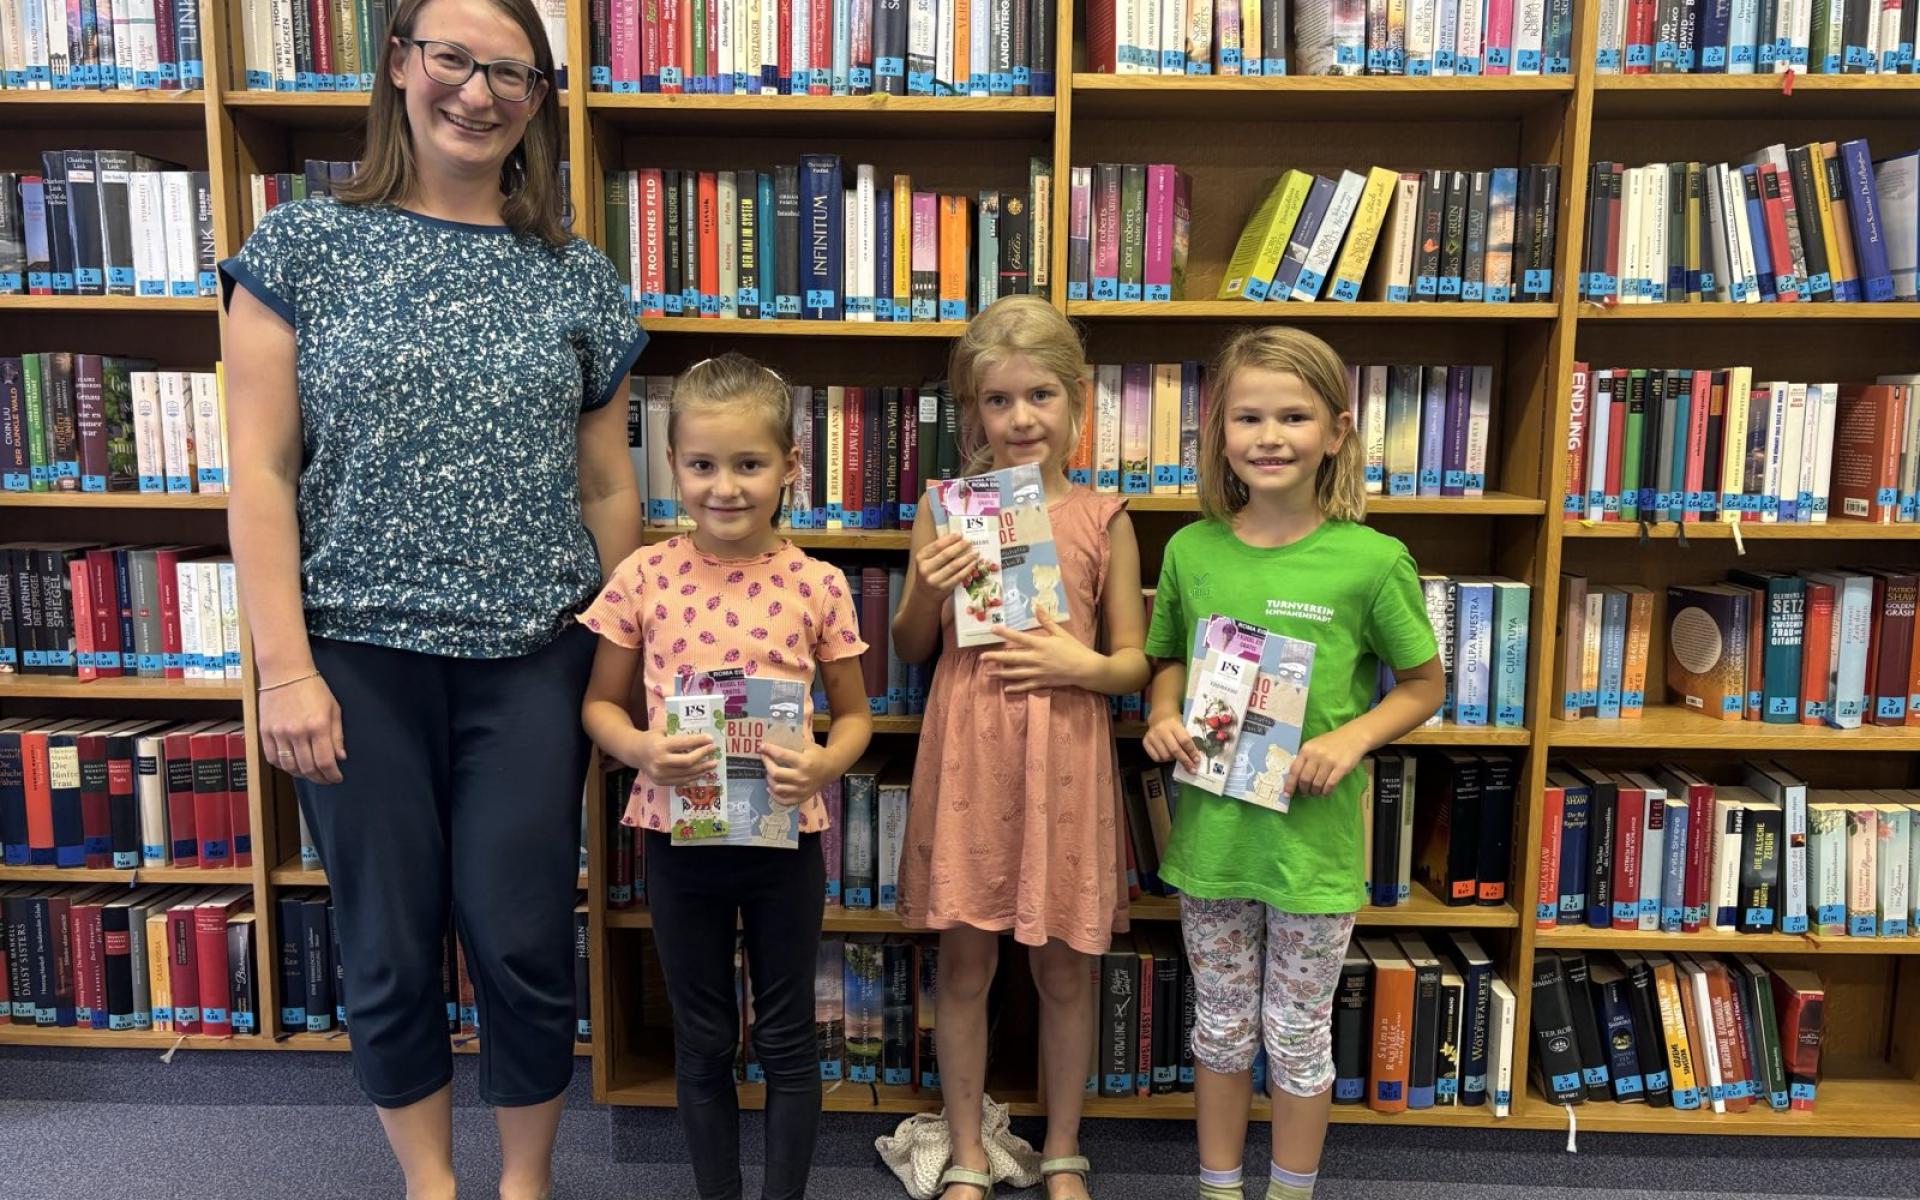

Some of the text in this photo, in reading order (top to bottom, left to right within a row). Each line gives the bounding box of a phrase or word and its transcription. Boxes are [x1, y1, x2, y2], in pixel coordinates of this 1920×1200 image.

[616, 13, 624, 58] JENNIFER
[1680, 19, 1688, 49] DAVID
[647, 179, 656, 276] TROCKENES FELD
[742, 198, 752, 226] SYSTEM
[813, 195, 828, 276] INFINITUM
[1125, 209, 1133, 268] nora roberts
[742, 255, 753, 268] DER
[832, 405, 840, 431] ANNA
[887, 401, 896, 428] Wahl
[1568, 372, 1586, 450] ENDLING
[5, 423, 13, 445] CIXIN
[13, 412, 21, 446] DUNKLE
[887, 431, 896, 449] Die
[849, 424, 859, 471] HEDWIG
[831, 469, 839, 496] ERIKA
[20, 572, 32, 626] LABYRINTH
[30, 573, 42, 626] DER SPIEGEL
[51, 574, 64, 627] SPIEGEL
[1266, 600, 1335, 615] TURNVEREIN
[1772, 600, 1805, 613] SETZ
[1265, 609, 1332, 623] SCHWANENSTADT
[1467, 597, 1479, 673] CULPA NUESTRA
[1506, 617, 1517, 673] CULPA TUYA
[726, 738, 762, 753] NDE
[727, 721, 763, 738] BLIO
[1754, 822, 1765, 870] DIE FALSCHE
[1764, 832, 1774, 860] ZEUGIN
[17, 923, 31, 996] DAISY SISTERS
[1378, 1018, 1388, 1058] Salman
[1540, 1026, 1573, 1038] TERROR
